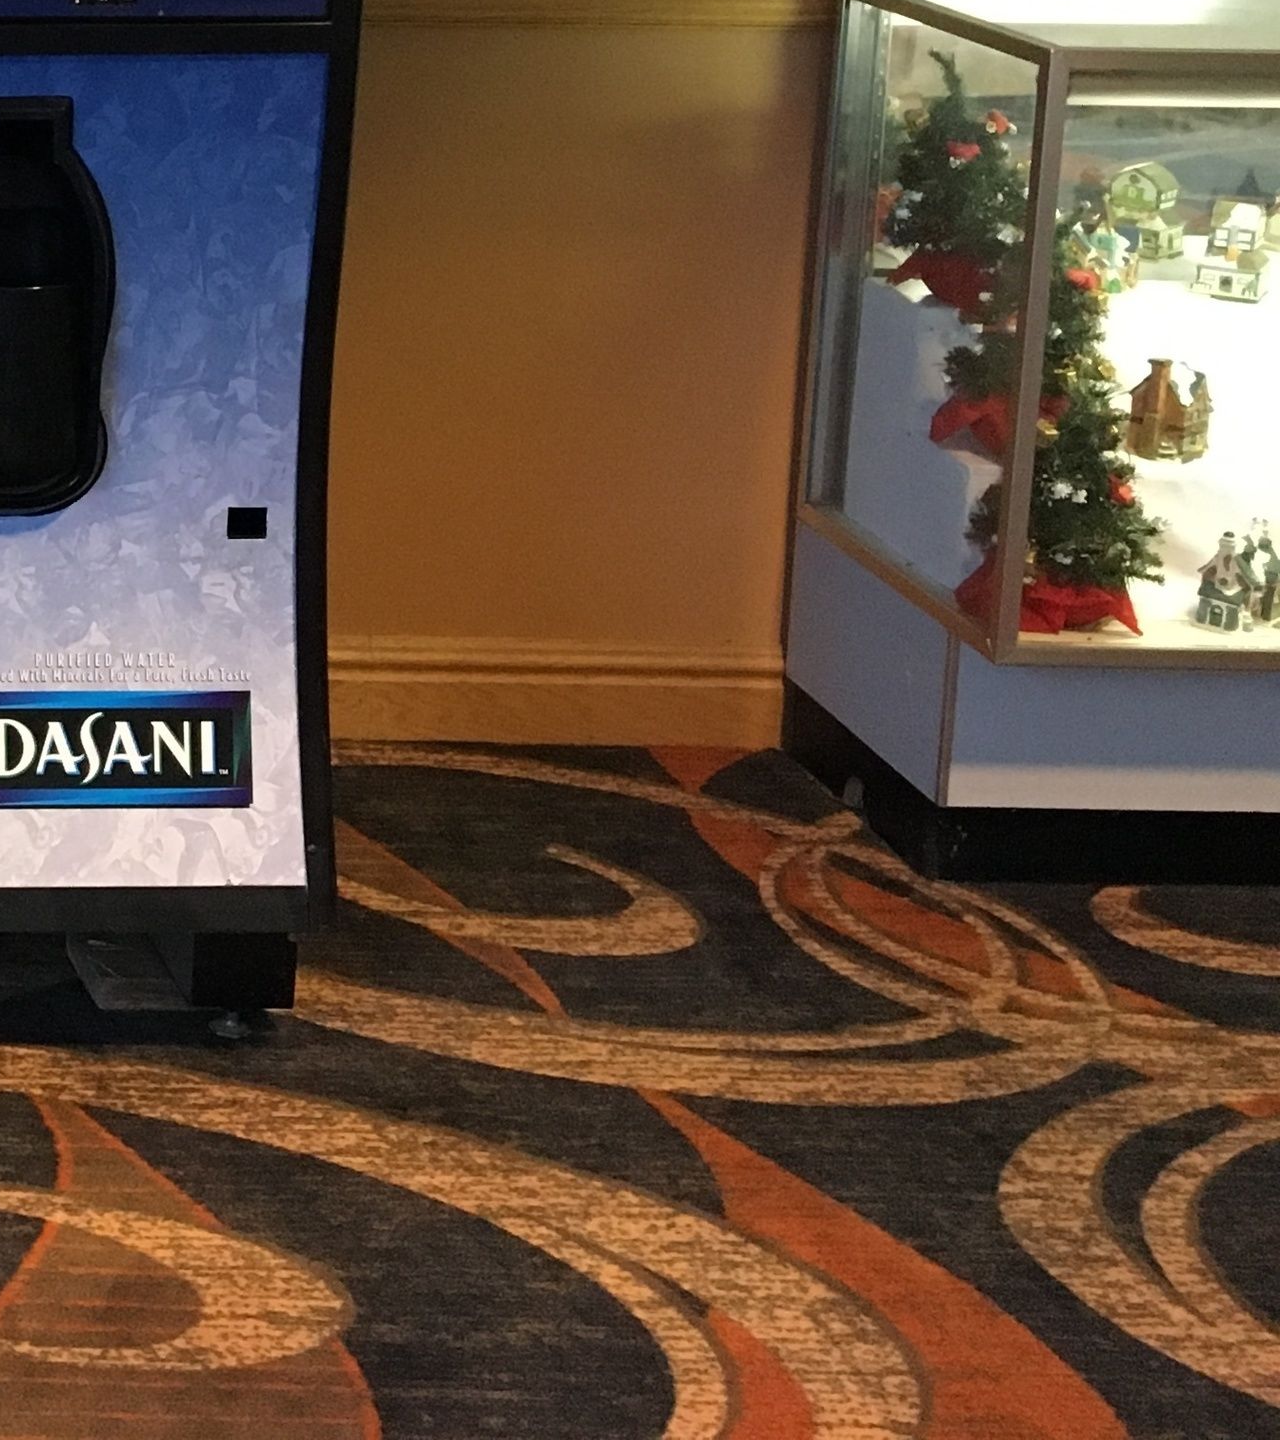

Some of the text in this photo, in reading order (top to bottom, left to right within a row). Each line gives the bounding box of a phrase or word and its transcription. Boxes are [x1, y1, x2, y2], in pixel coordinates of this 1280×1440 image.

[34, 653, 175, 668] PURIFIED WATER
[18, 669, 48, 683] With
[52, 668, 104, 683] Minerals
[109, 668, 129, 683] For
[133, 672, 140, 682] a
[181, 667, 215, 682] Fresh
[218, 667, 252, 682] Taste
